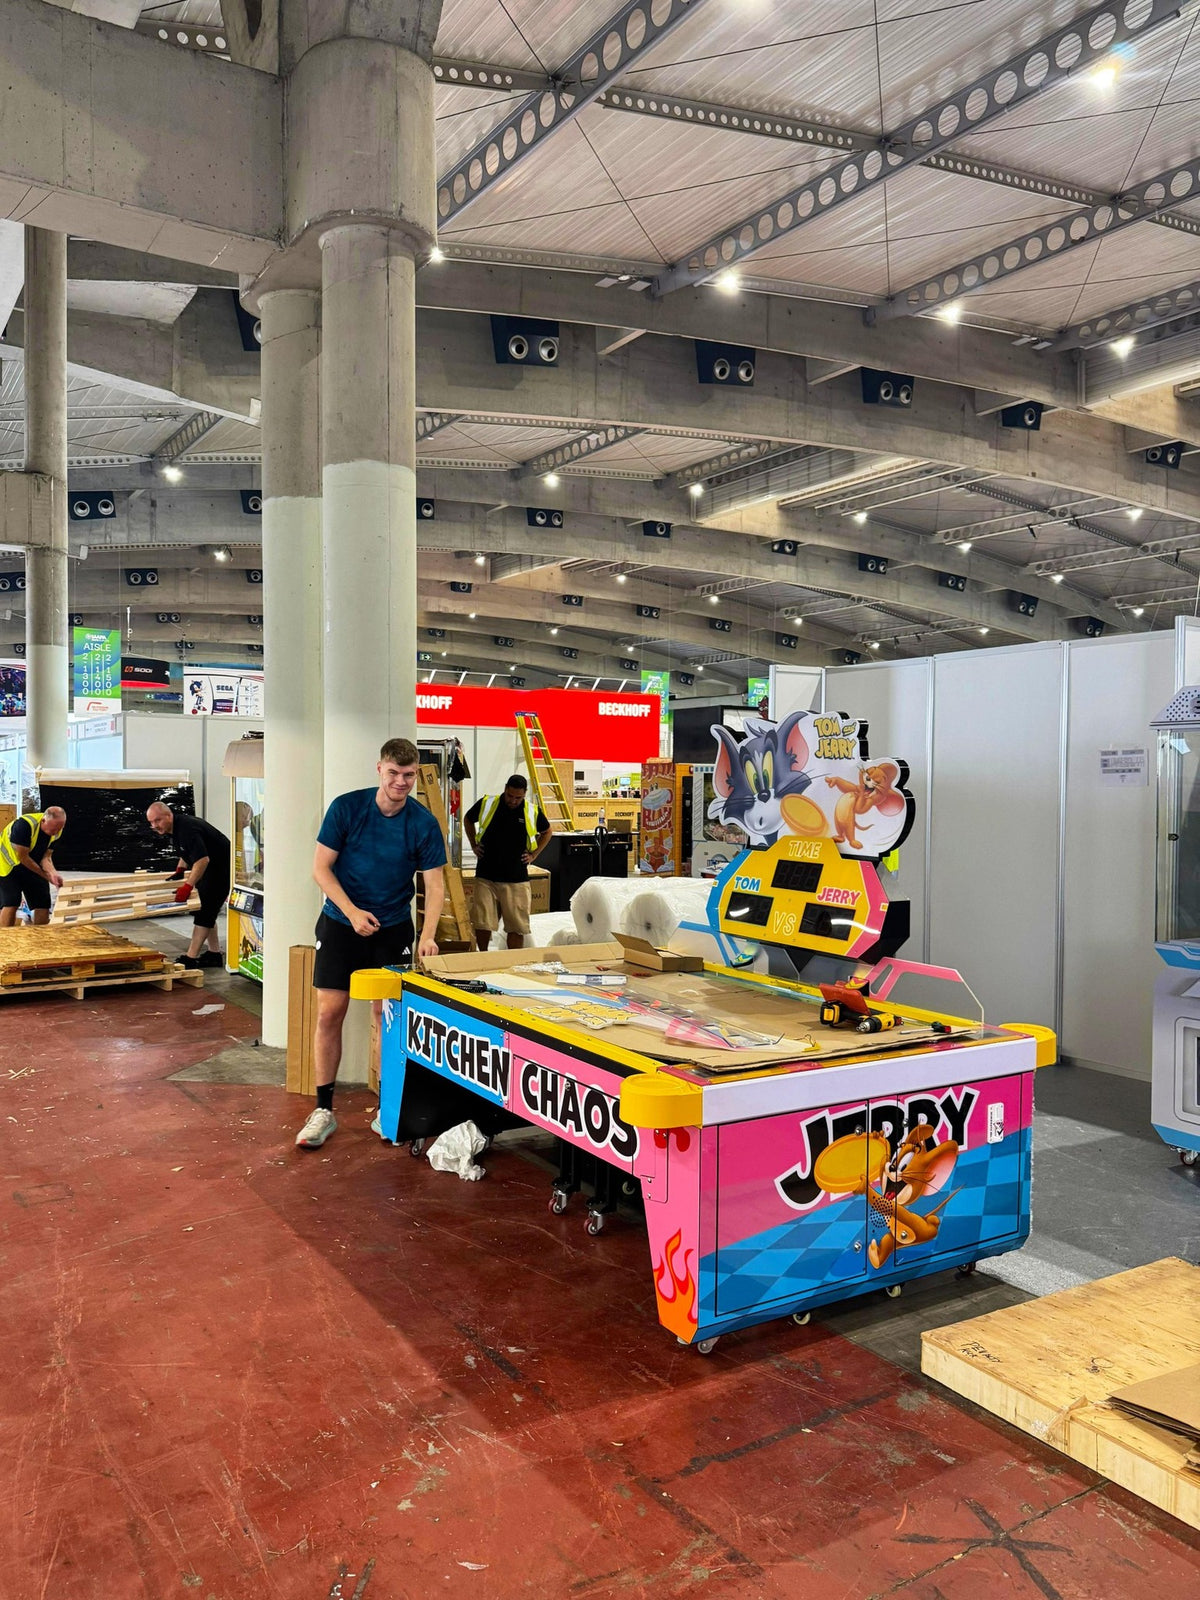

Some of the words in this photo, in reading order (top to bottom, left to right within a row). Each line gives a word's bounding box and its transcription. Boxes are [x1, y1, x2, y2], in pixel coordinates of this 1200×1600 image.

[83, 642, 112, 652] AISLE
[598, 701, 651, 717] BECKHOFF
[813, 716, 841, 737] TOM
[815, 738, 857, 760] JERRY
[788, 840, 823, 859] TIME
[734, 875, 761, 892] TOM
[816, 886, 862, 906] JERRY
[772, 910, 797, 936] VS
[406, 1009, 512, 1098] KITCHEN
